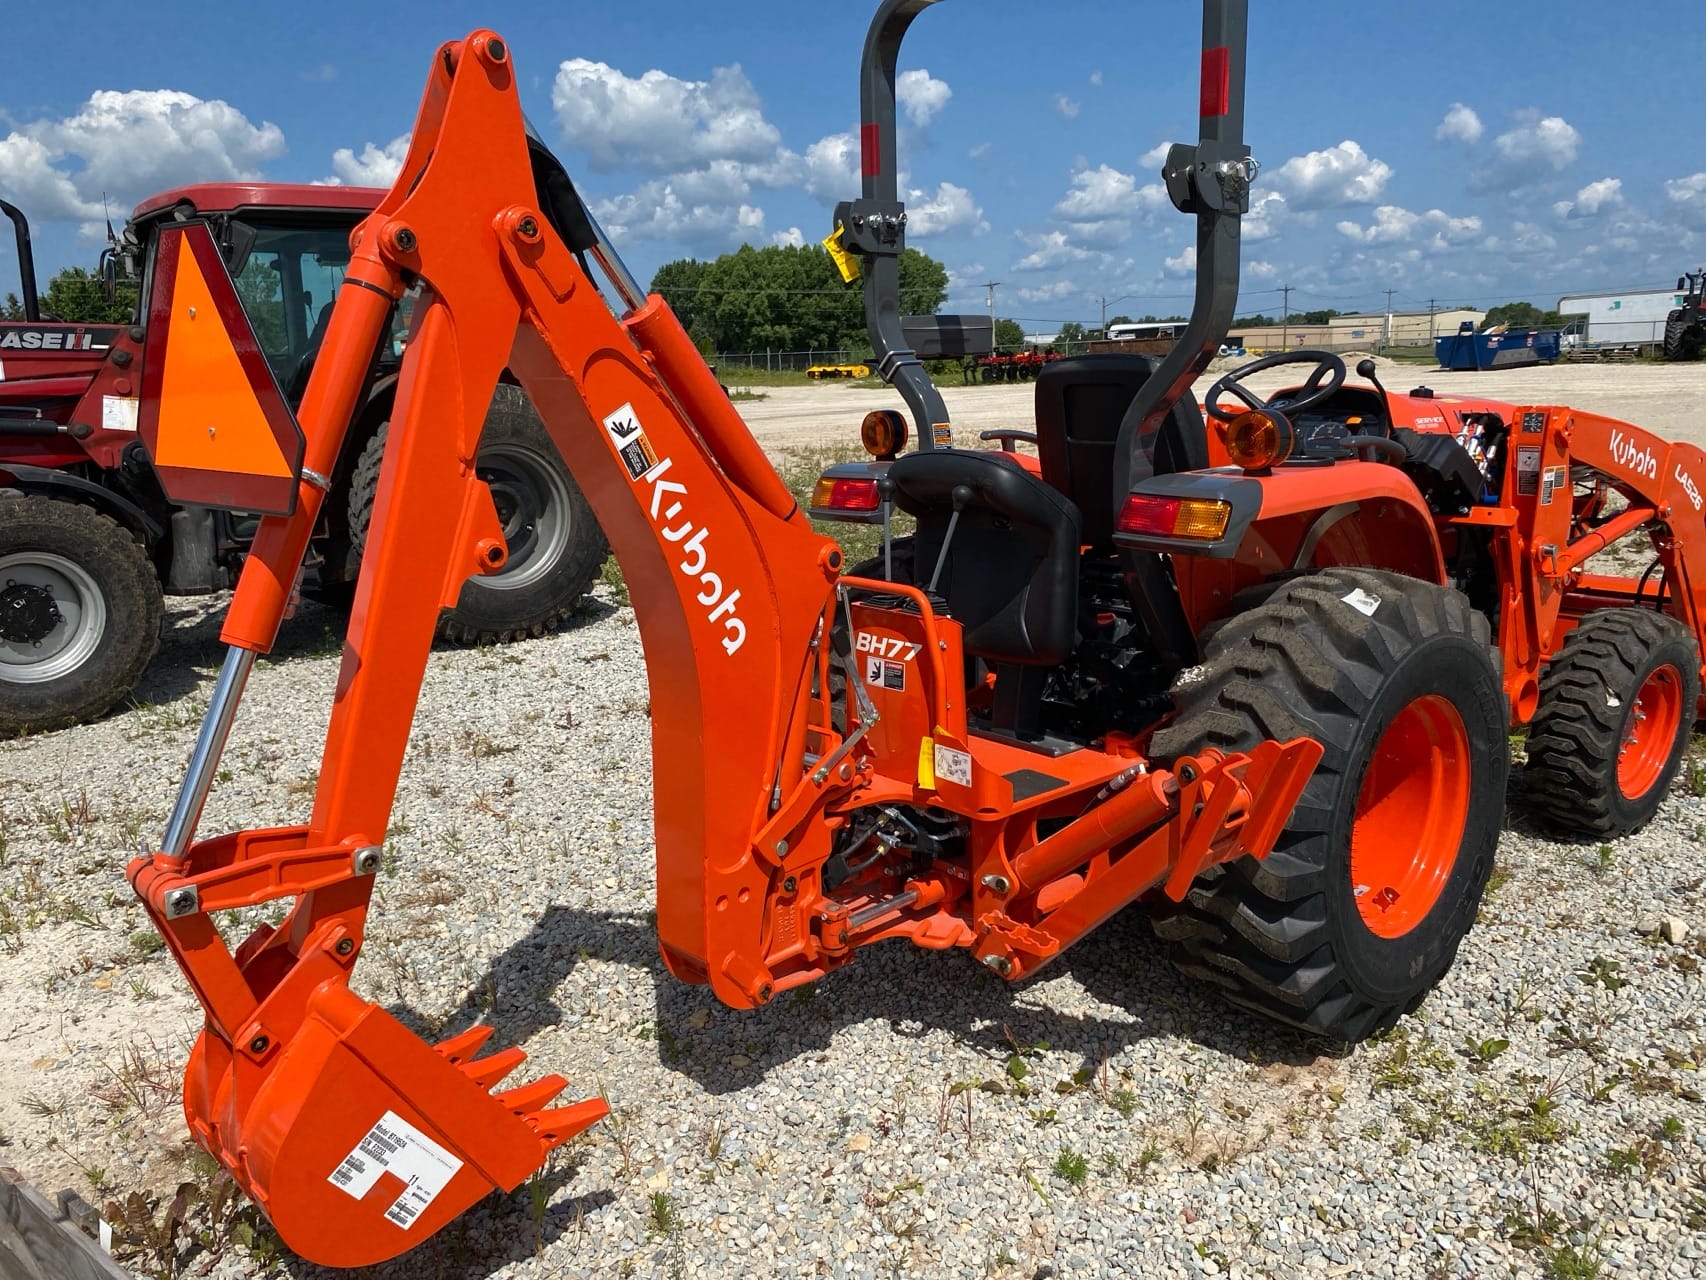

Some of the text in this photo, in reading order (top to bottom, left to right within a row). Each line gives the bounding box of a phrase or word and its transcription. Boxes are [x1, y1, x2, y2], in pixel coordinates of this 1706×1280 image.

[0, 331, 63, 349] ASE
[1609, 429, 1657, 480] Kubota
[1675, 464, 1703, 511] LA526
[645, 457, 746, 656] Kubota
[856, 632, 922, 661] BH77
[375, 1123, 389, 1137] Model
